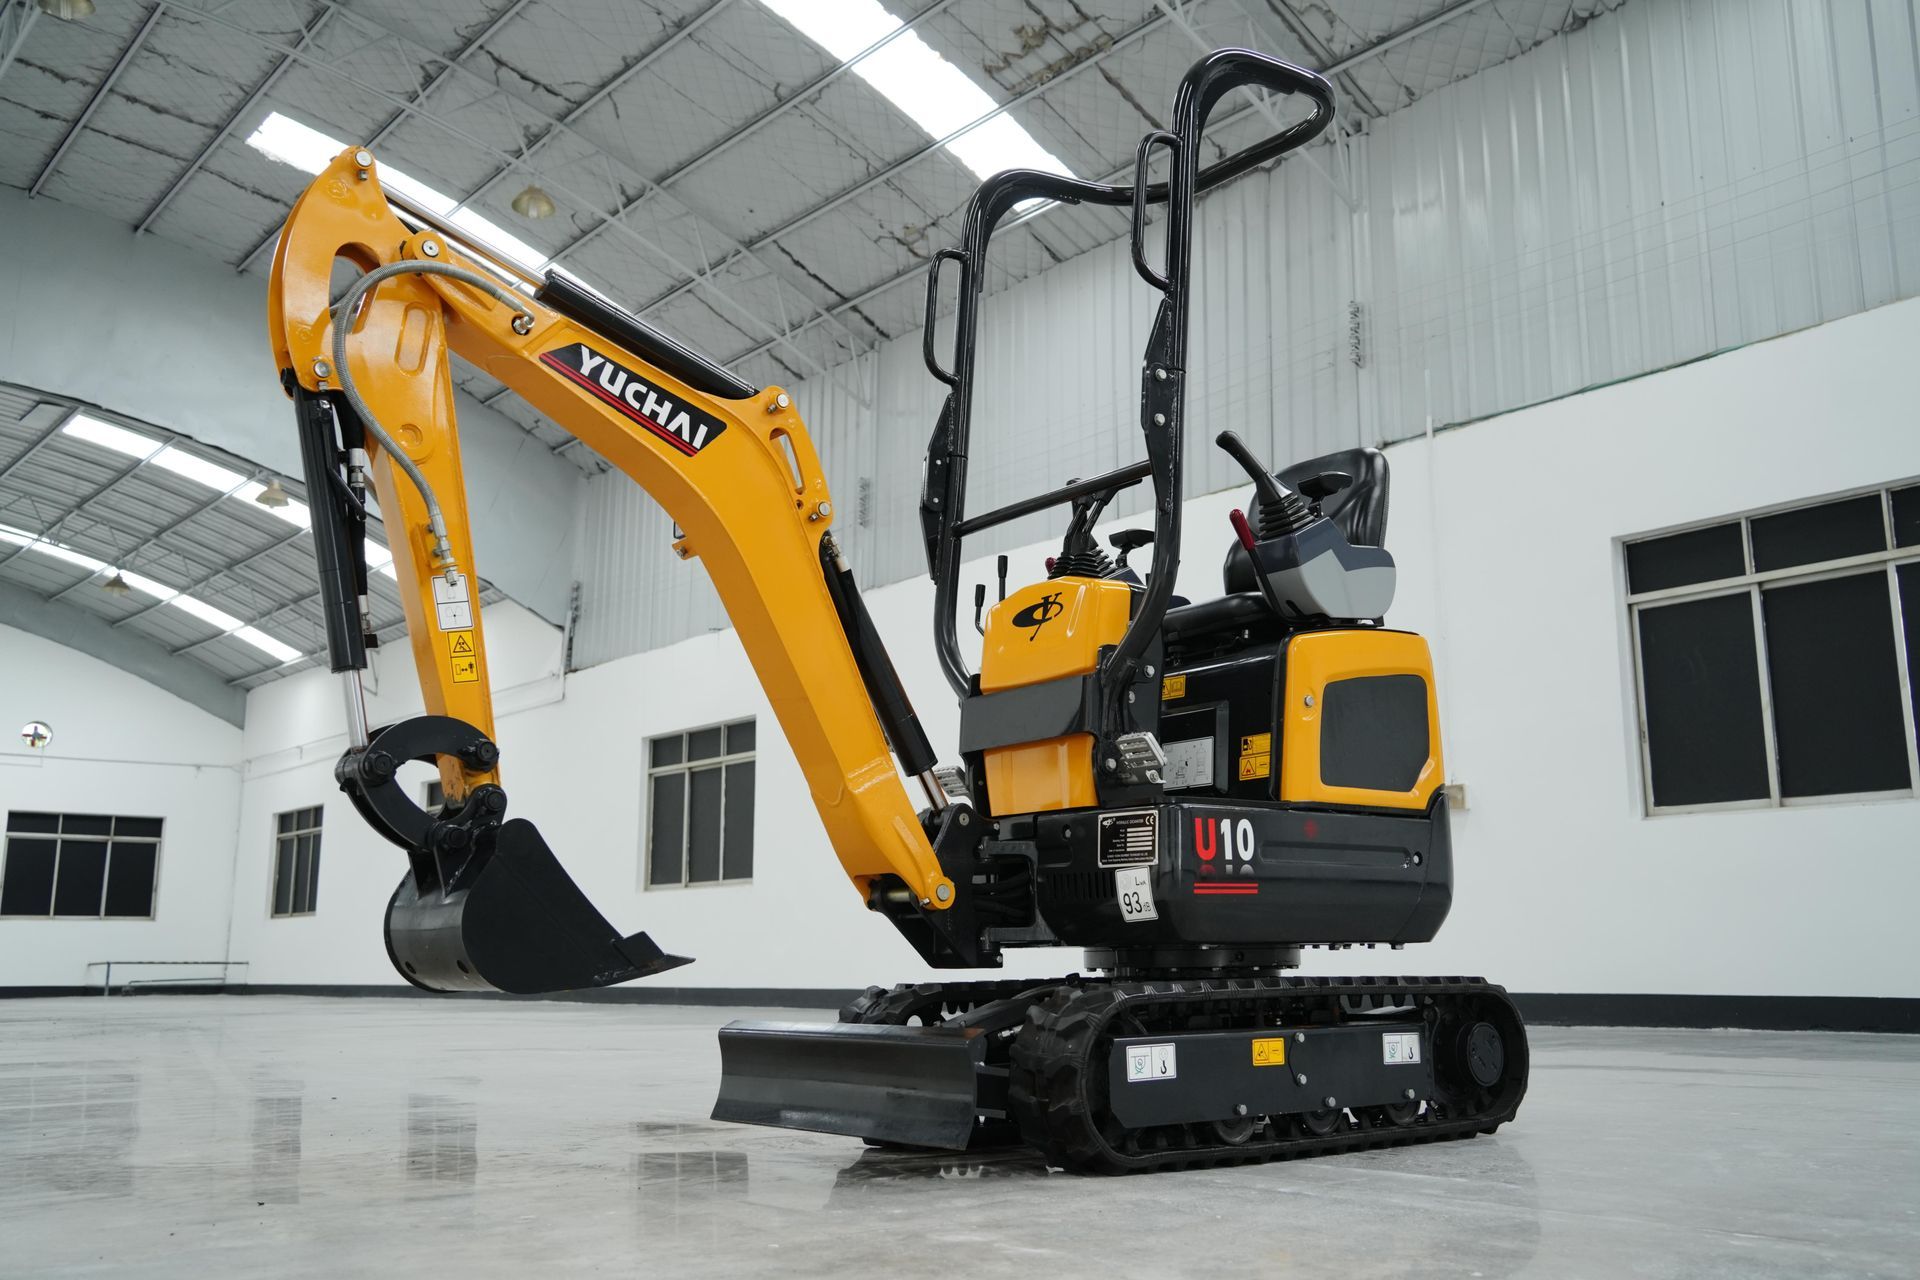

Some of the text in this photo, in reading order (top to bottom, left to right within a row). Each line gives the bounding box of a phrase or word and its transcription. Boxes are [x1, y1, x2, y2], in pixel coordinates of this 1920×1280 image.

[580, 345, 708, 450] YUCHAI
[1195, 818, 1255, 861] U10
[1123, 892, 1142, 914] 93
